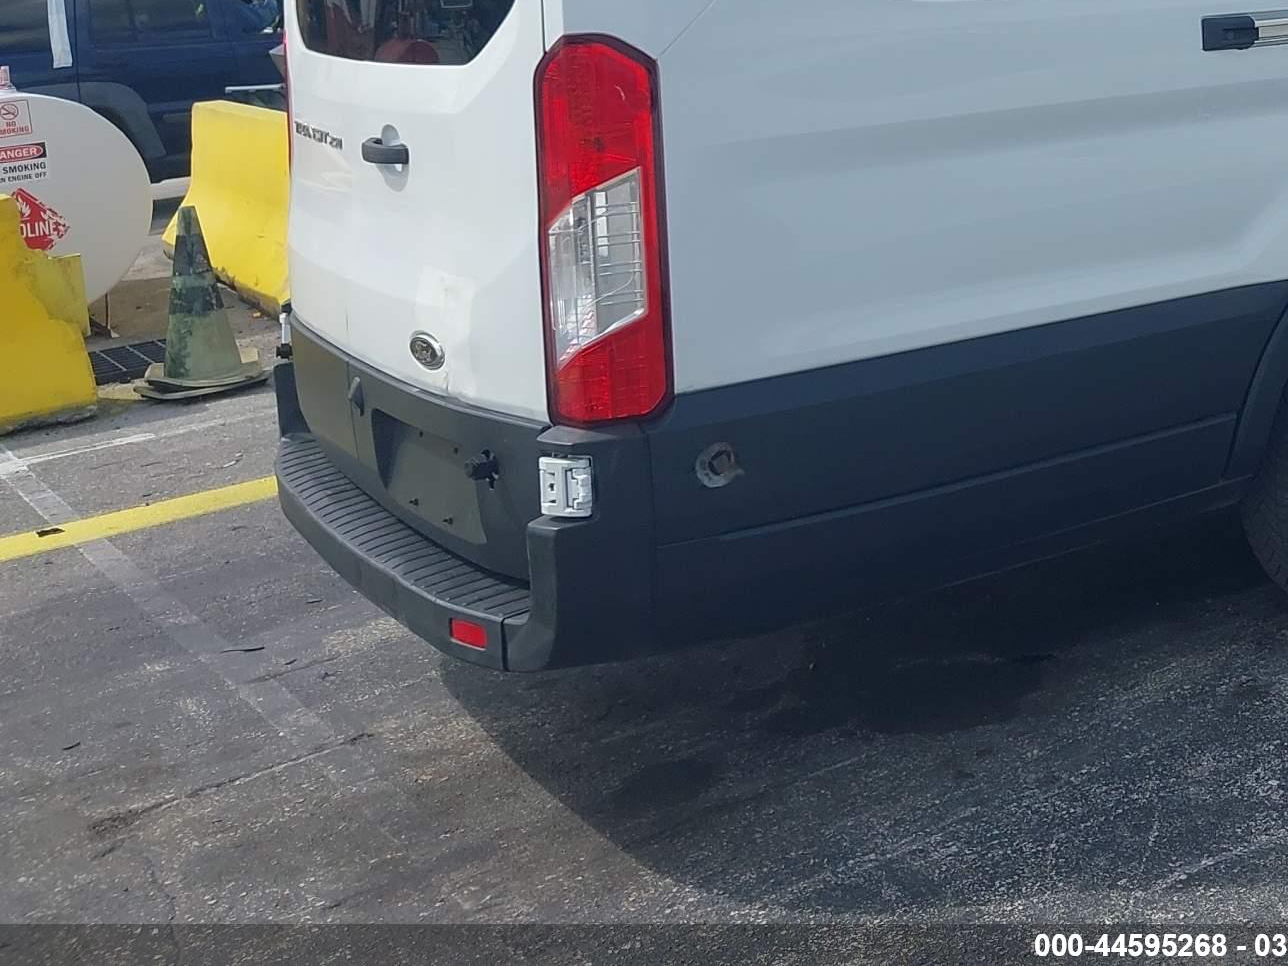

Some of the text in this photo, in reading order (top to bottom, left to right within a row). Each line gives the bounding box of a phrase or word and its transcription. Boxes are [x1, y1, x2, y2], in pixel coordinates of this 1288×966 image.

[0, 126, 30, 134] MOKING
[0, 148, 38, 159] ANGER
[2, 162, 46, 174] SMOKING
[8, 173, 33, 183] ENGINE
[35, 171, 47, 179] OFF
[20, 220, 59, 238] OLINE
